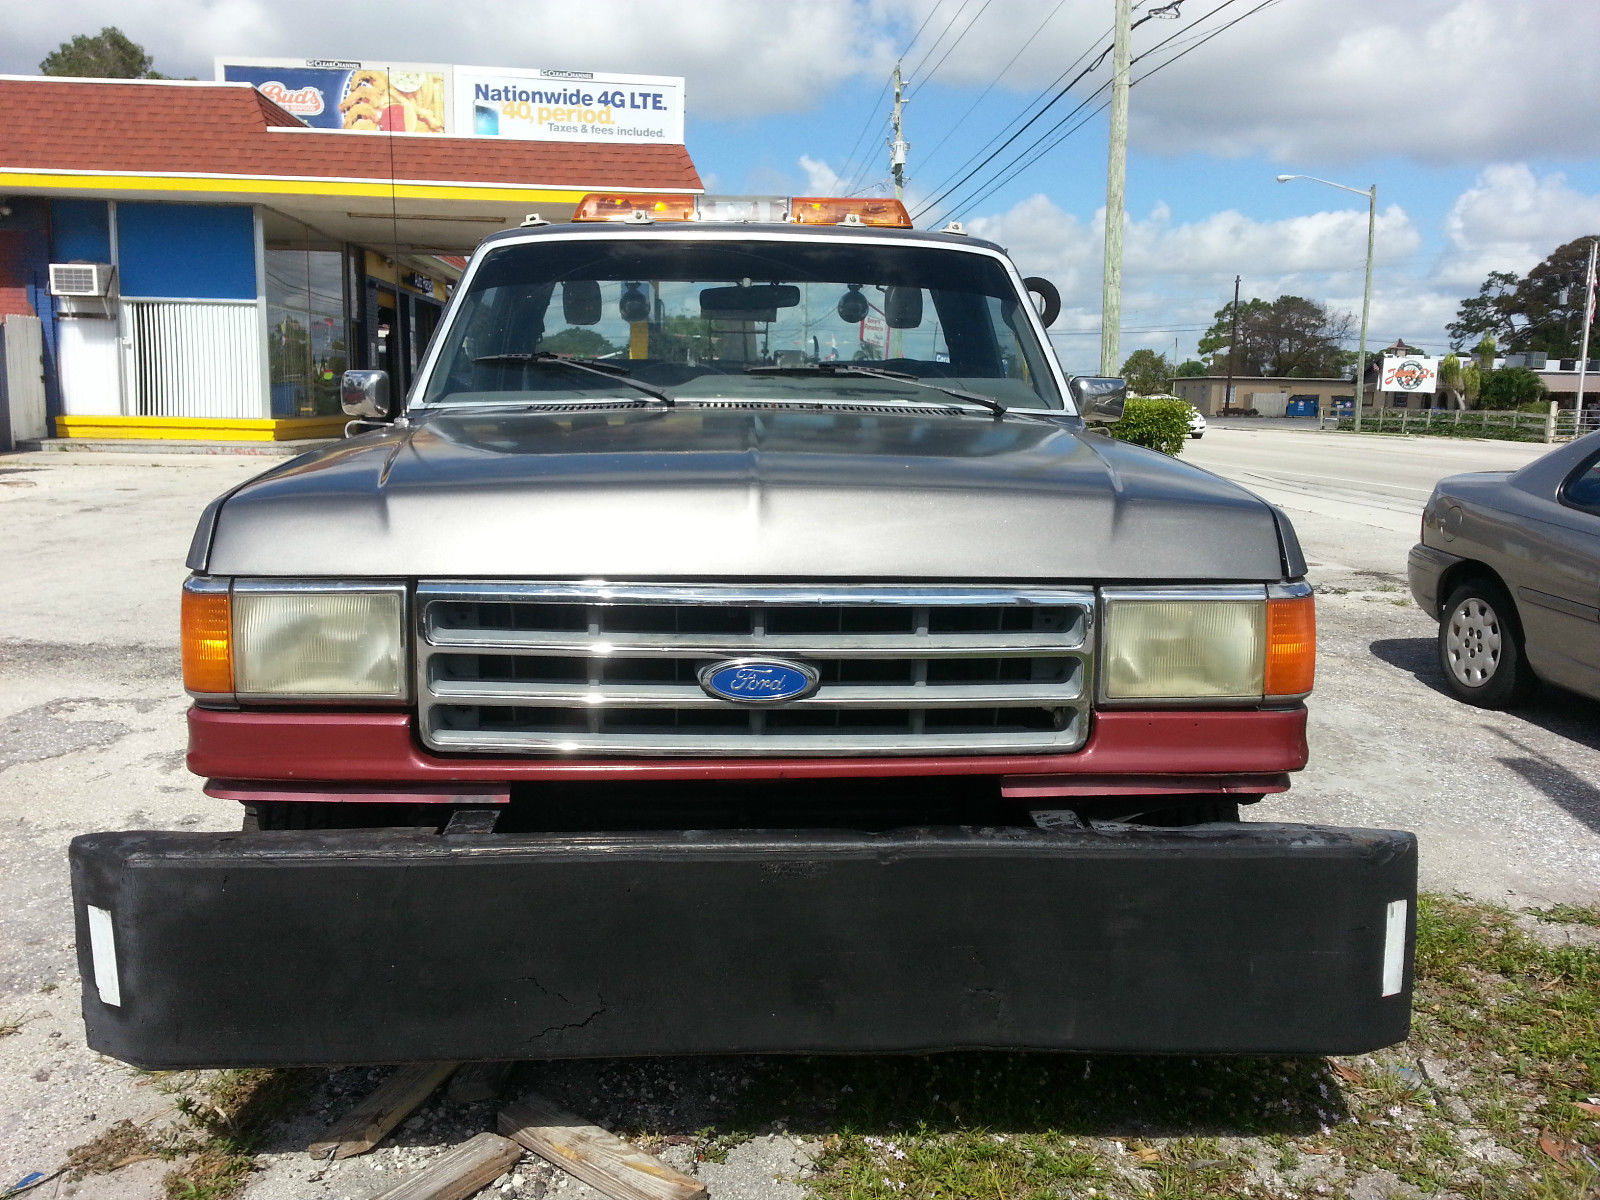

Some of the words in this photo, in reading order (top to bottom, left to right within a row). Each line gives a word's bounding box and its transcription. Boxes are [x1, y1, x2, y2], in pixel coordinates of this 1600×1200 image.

[261, 84, 321, 111] Bud's
[475, 83, 593, 106] Nationwide
[597, 91, 626, 108] 4G
[630, 92, 667, 110] LTE.
[538, 104, 615, 125] period.
[547, 123, 579, 132] Taxes
[580, 124, 588, 133] &
[591, 125, 614, 135] fees
[617, 126, 666, 137] included.
[730, 668, 786, 691] Ford
